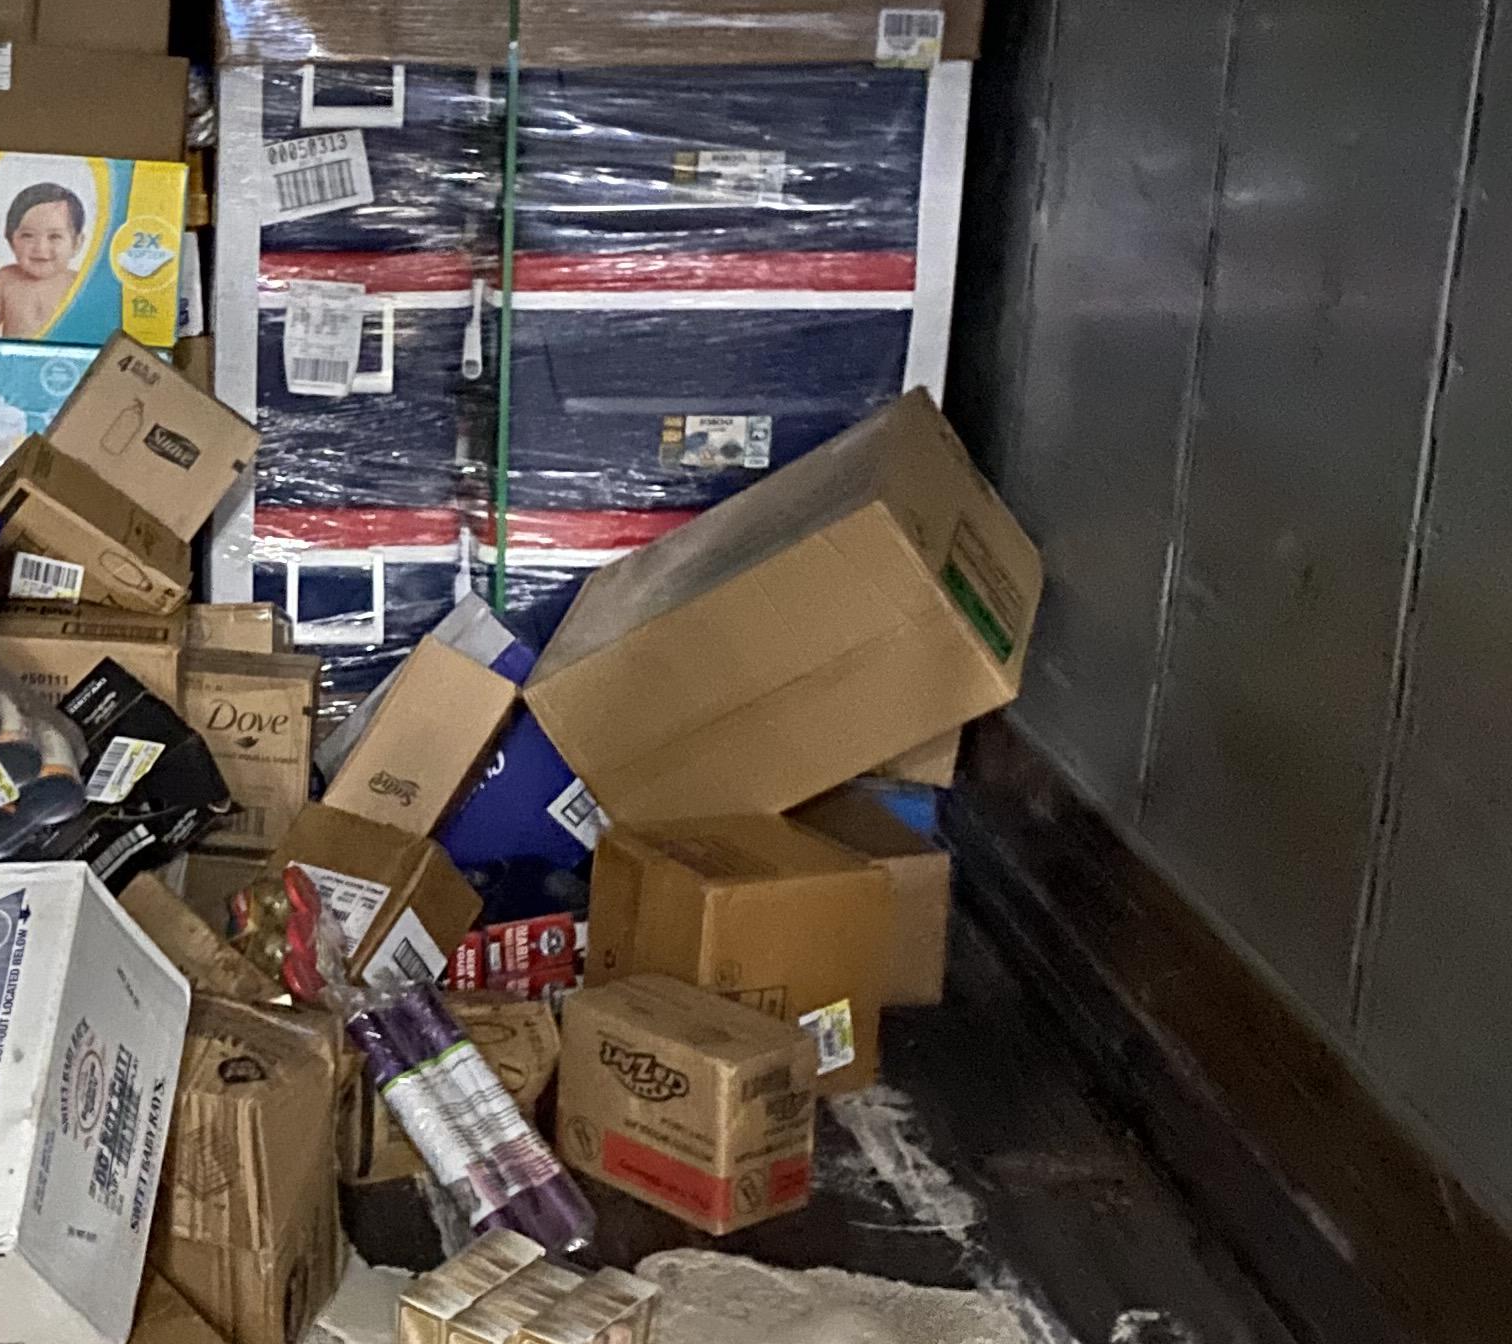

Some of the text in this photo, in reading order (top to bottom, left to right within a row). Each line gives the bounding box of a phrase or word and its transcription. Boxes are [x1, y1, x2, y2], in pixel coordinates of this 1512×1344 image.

[206, 698, 288, 734] Dove
[2, 968, 20, 1016] LOCATED
[13, 929, 28, 966] BELOW
